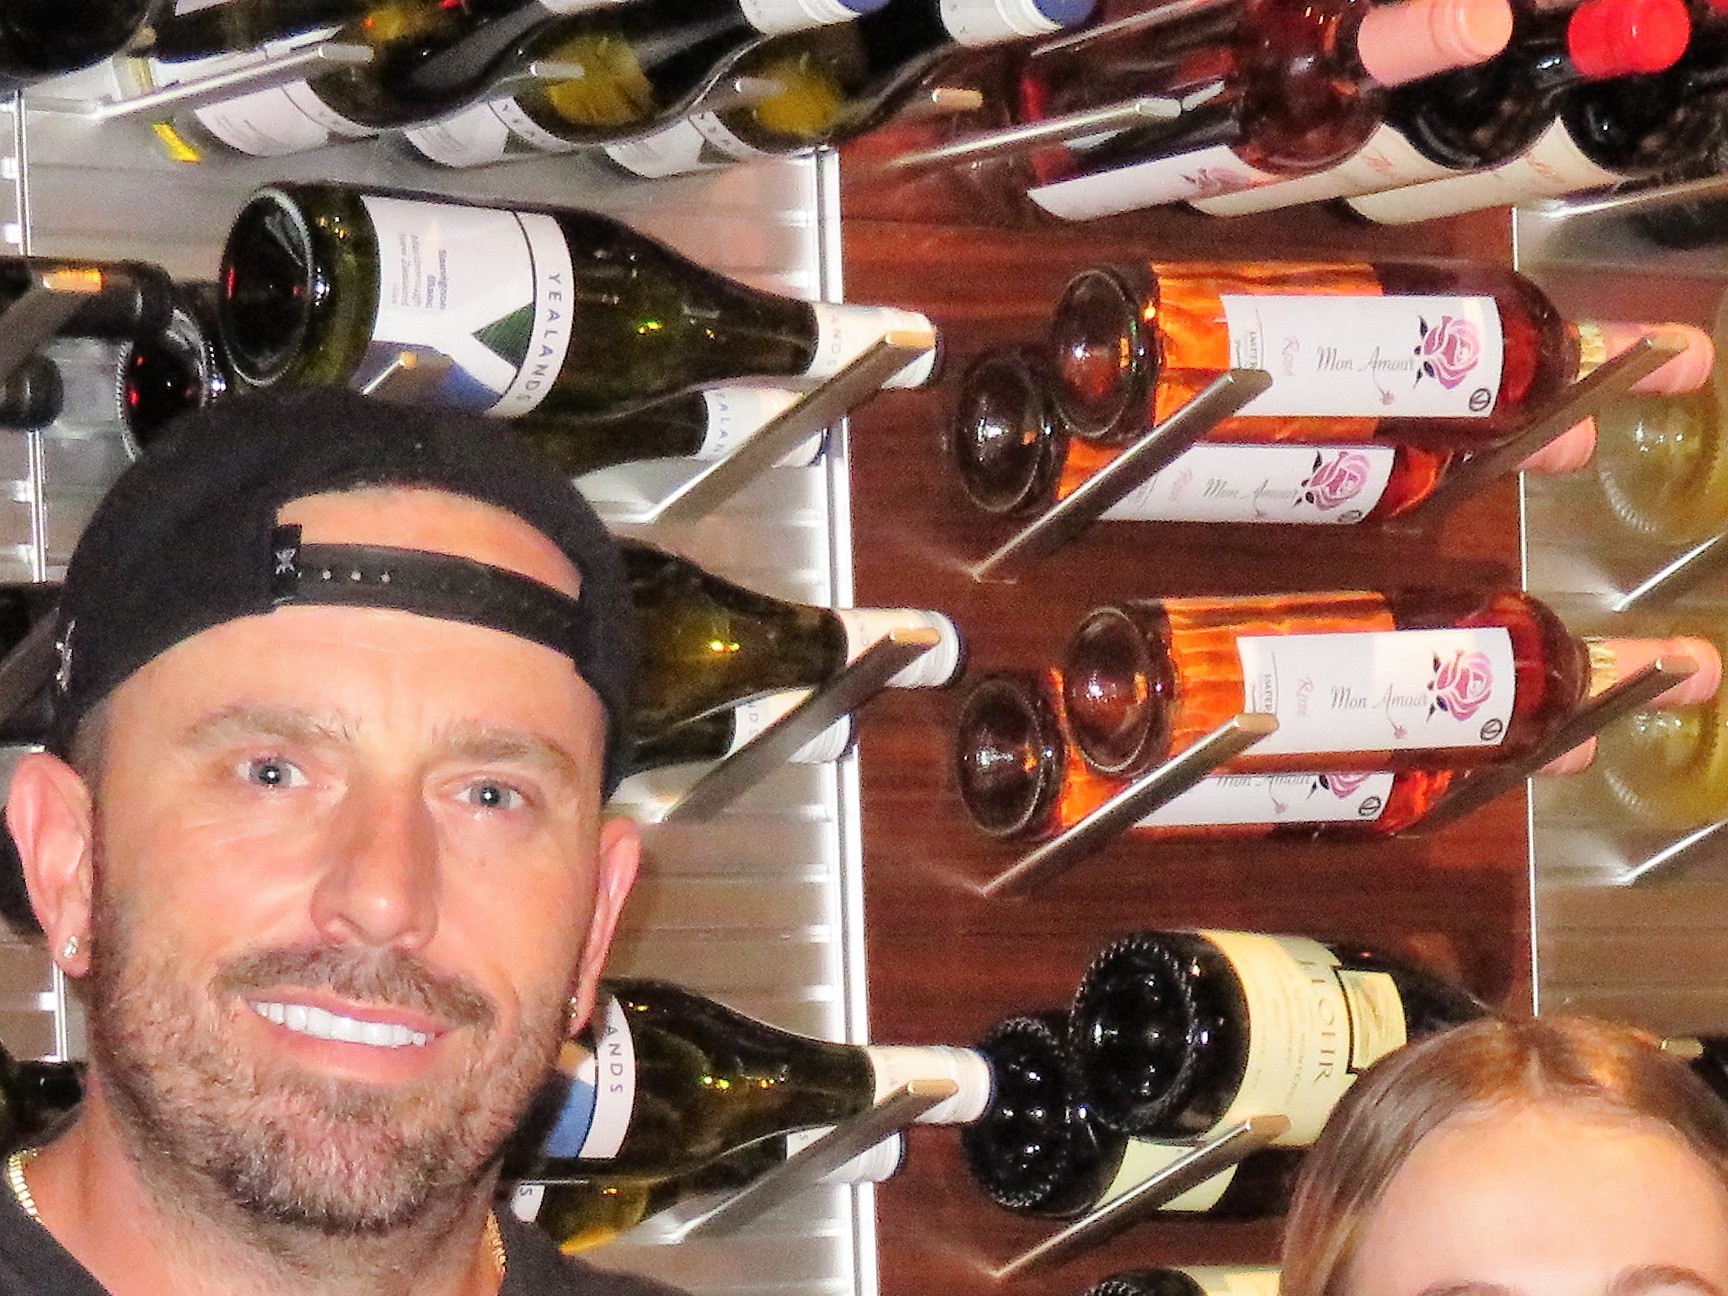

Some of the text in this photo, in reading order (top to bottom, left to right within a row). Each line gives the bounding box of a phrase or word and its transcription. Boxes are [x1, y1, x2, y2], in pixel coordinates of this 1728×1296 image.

[515, 273, 563, 401] YEALANDS
[1316, 345, 1415, 374] Mon Amour
[1329, 683, 1428, 711] Mon Amour
[605, 1025, 623, 1094] ANDS
